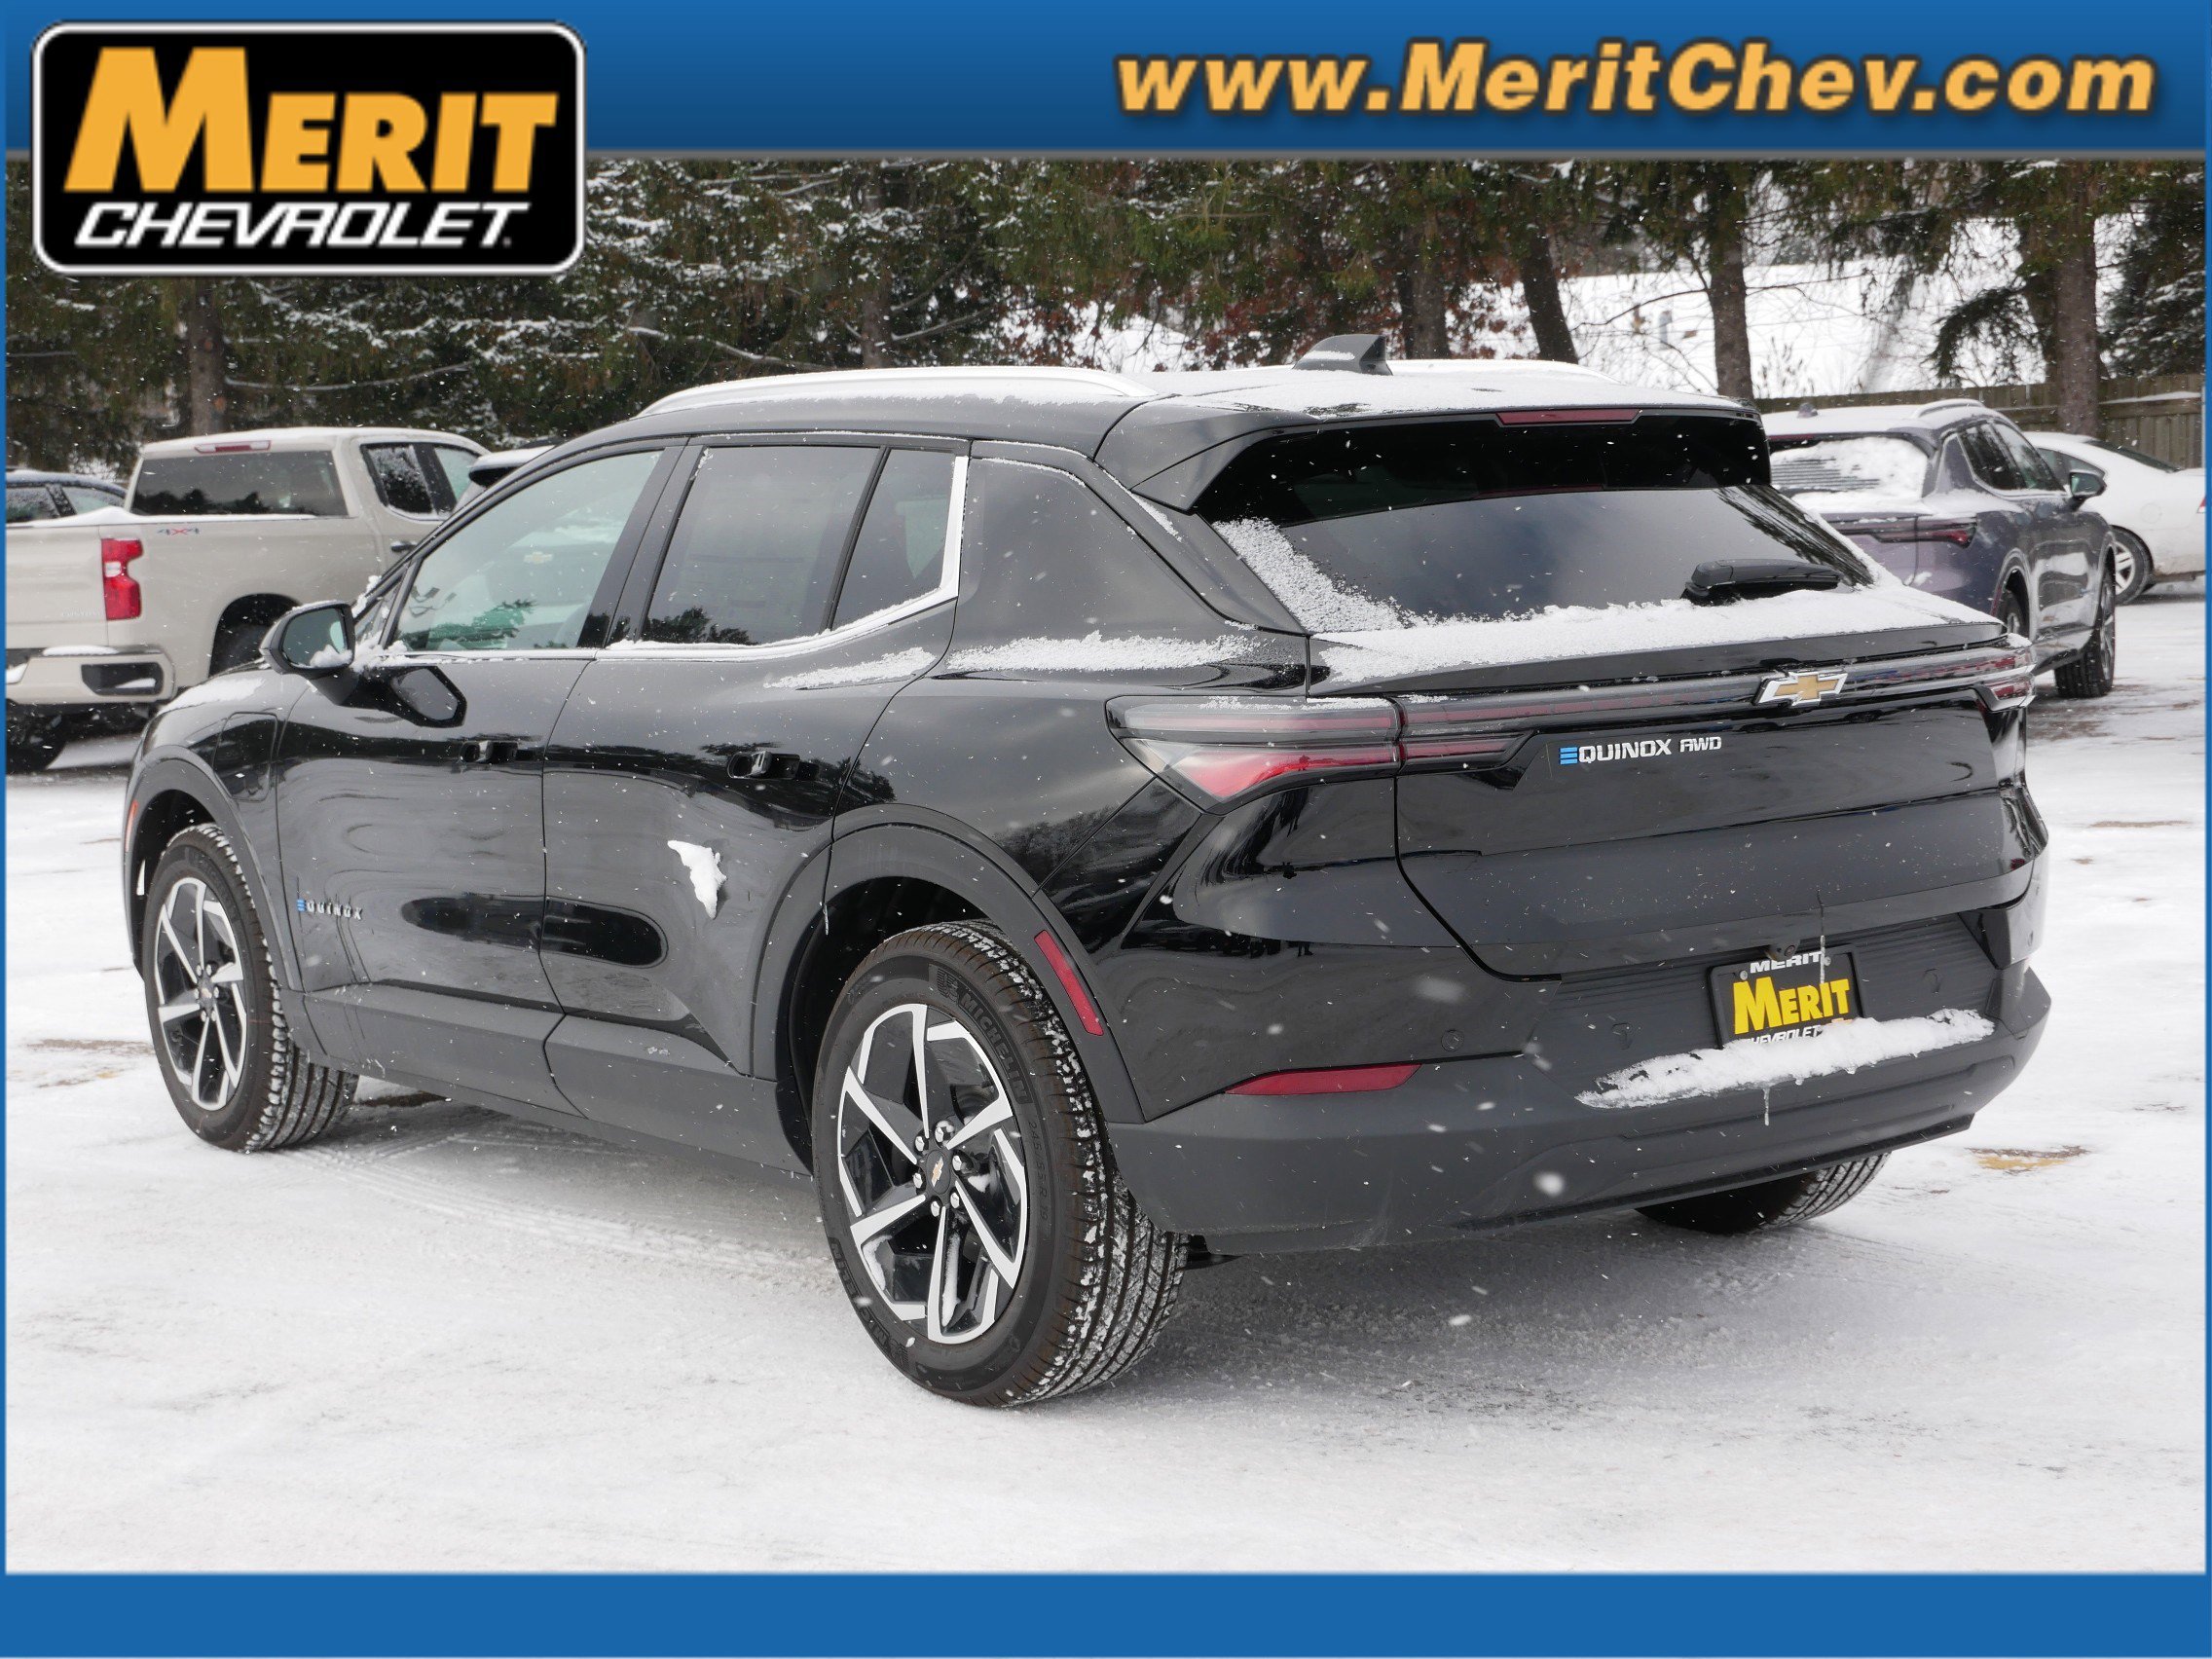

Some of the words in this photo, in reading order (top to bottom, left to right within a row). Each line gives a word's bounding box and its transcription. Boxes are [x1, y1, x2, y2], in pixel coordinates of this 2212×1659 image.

[1560, 738, 1672, 765] EQUINOX
[1679, 736, 1722, 753] AWD
[296, 898, 363, 921] EQUINOX
[1733, 976, 1851, 1035] MERIT
[959, 991, 1032, 1099] MICHELIN
